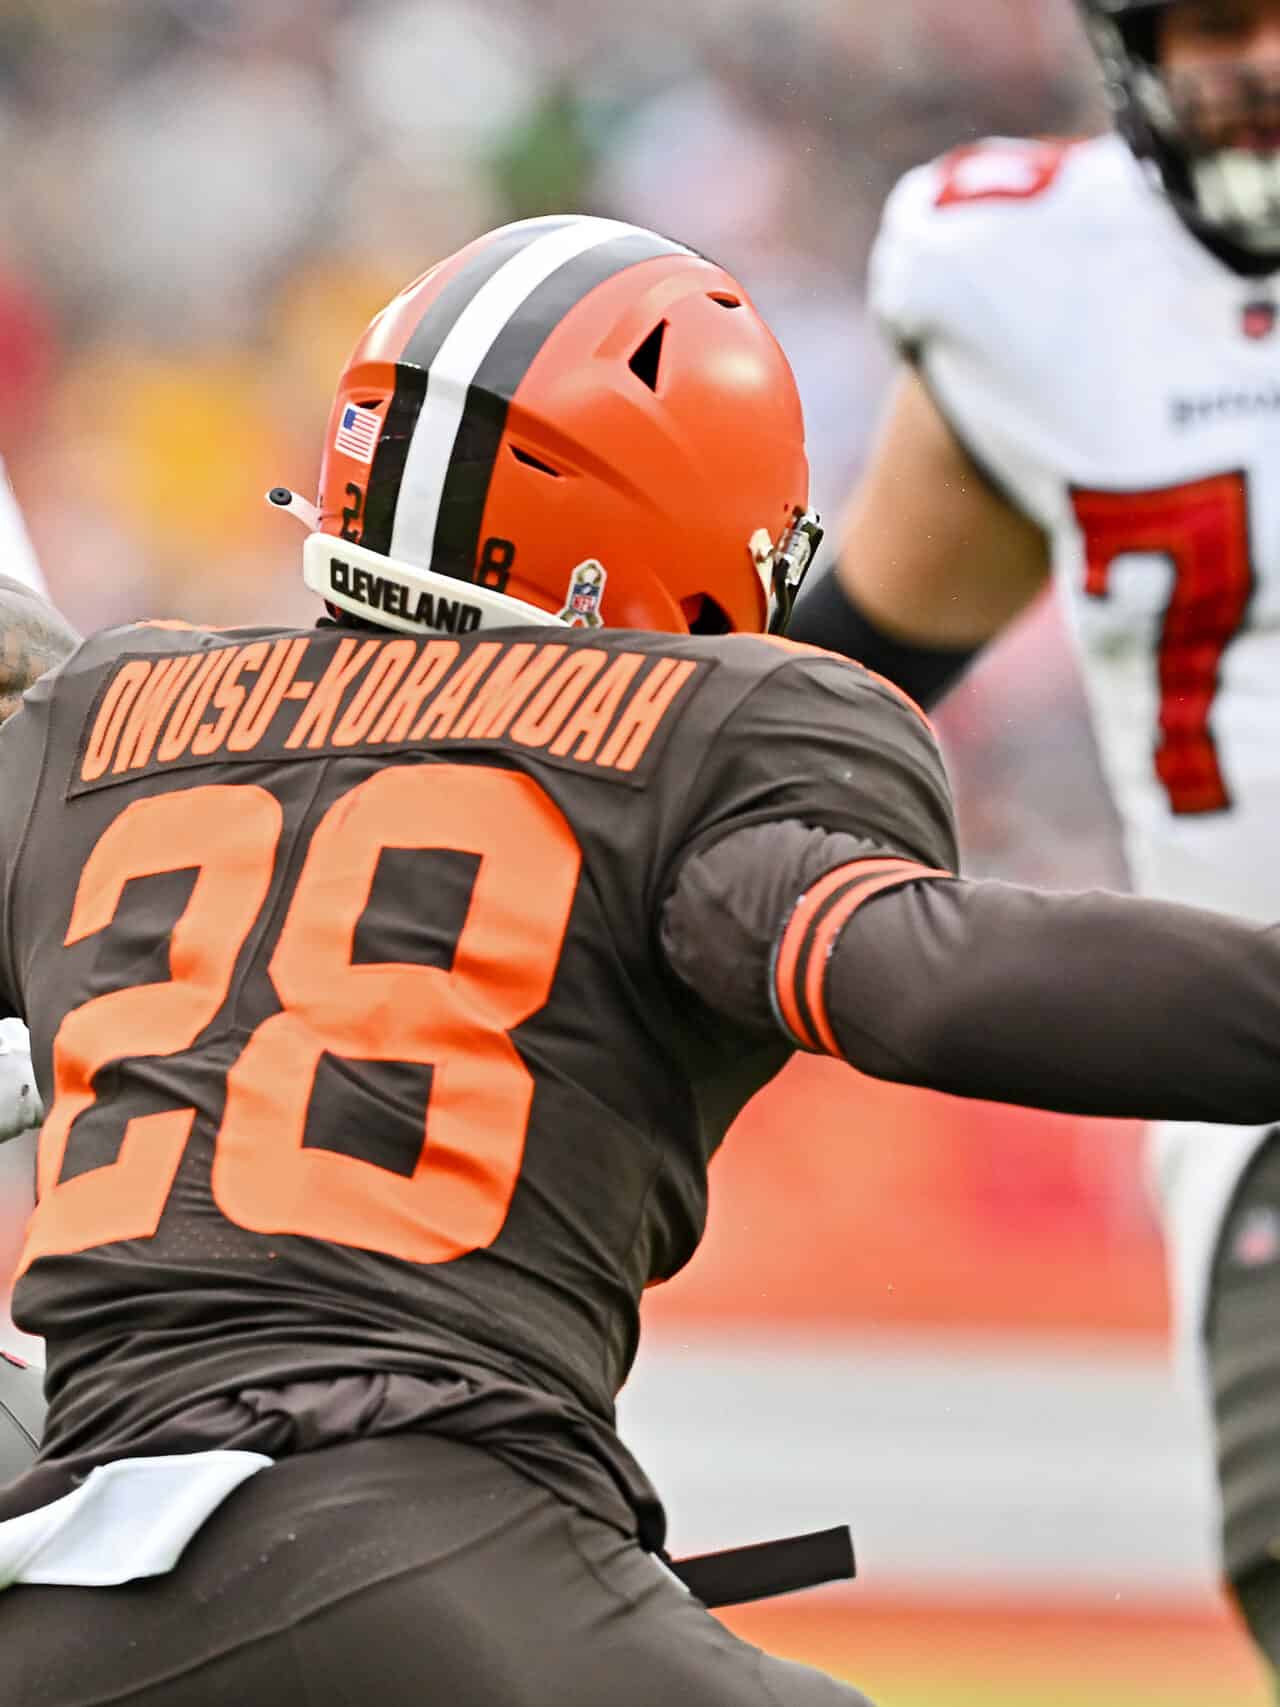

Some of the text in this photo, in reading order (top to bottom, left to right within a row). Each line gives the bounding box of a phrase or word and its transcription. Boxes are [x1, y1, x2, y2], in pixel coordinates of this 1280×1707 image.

[330, 557, 483, 635] CLEVELAND
[81, 638, 697, 782] OWUSU-KORAMOAH
[17, 764, 582, 1276] 28
